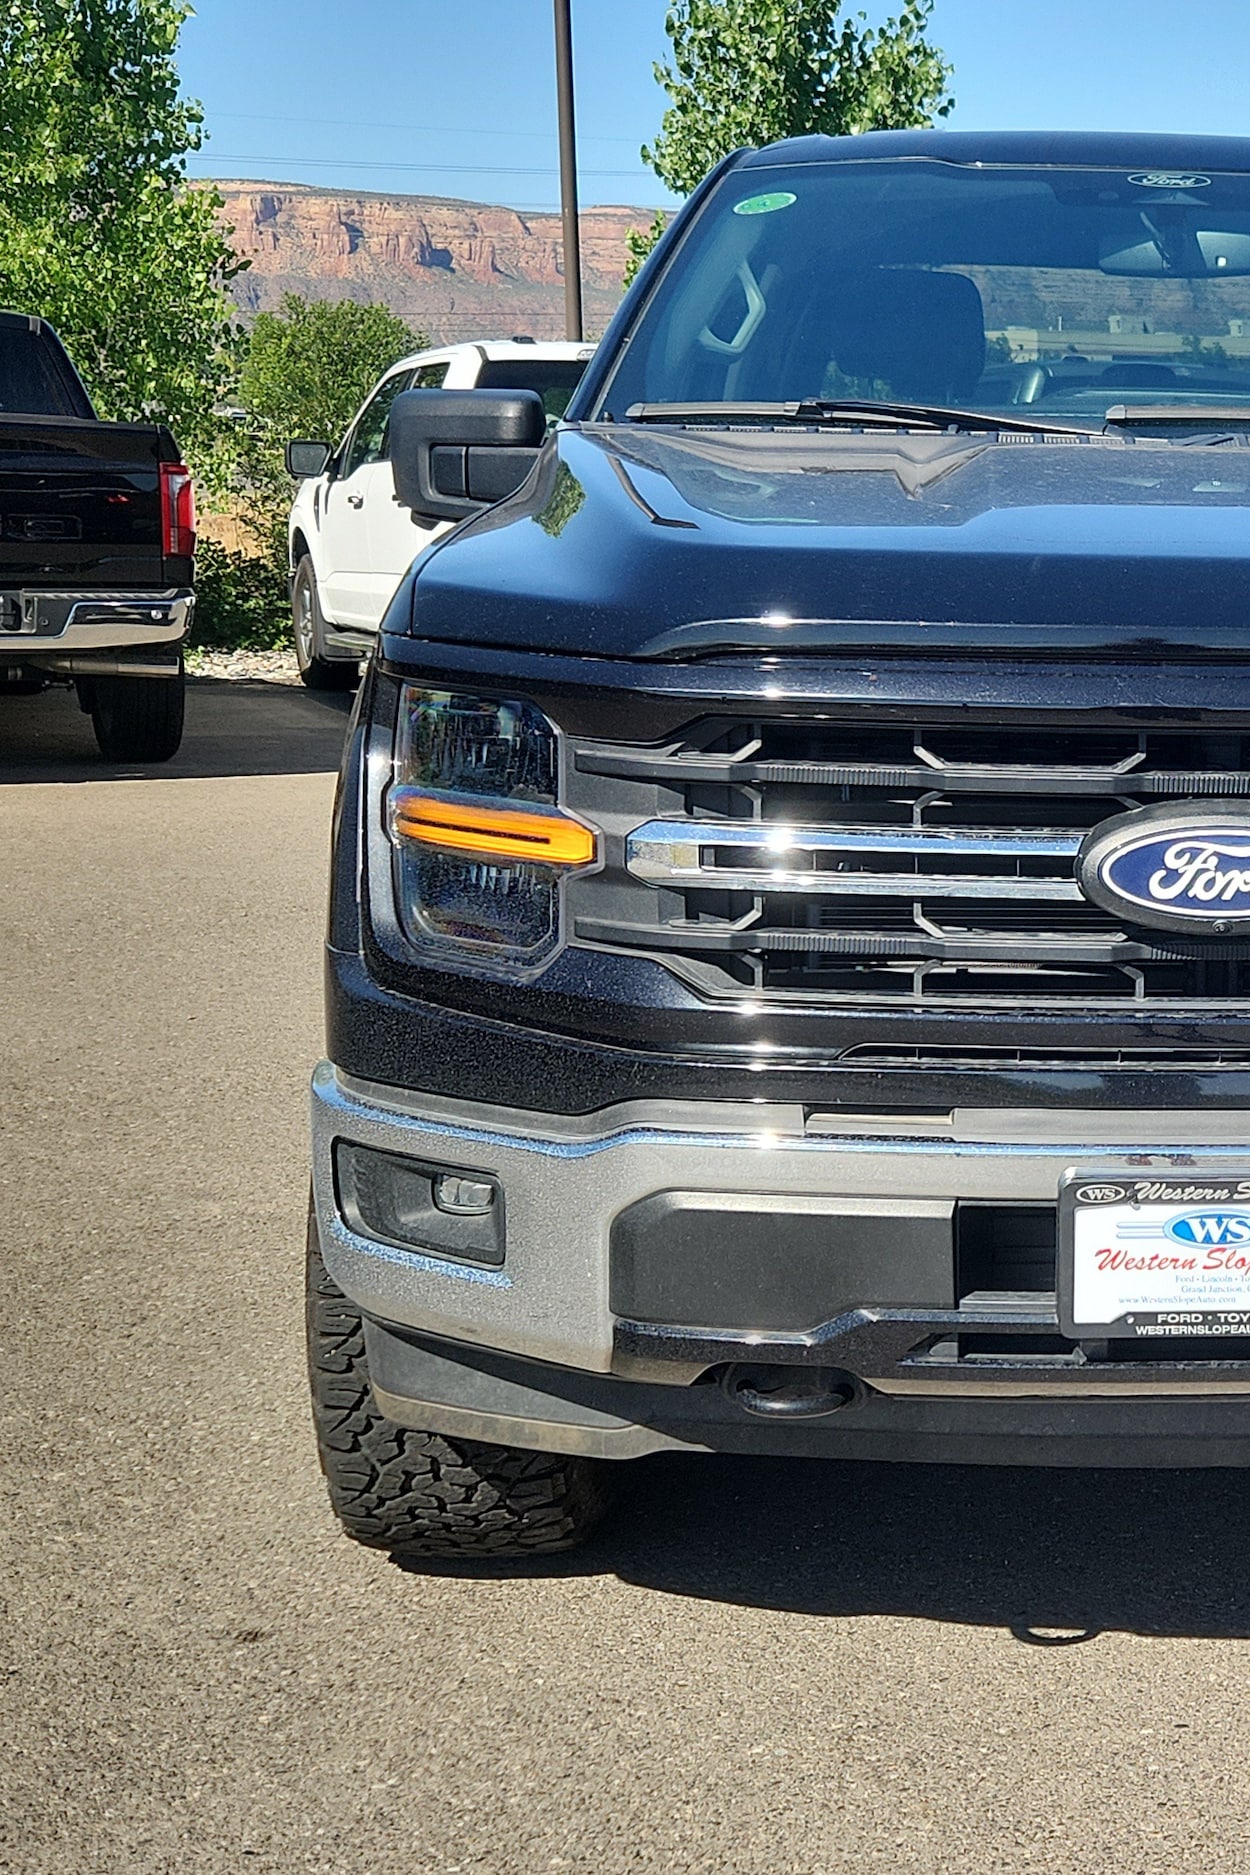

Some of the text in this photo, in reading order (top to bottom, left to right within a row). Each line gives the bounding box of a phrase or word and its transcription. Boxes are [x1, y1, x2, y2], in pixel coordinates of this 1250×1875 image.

[1142, 173, 1196, 186] Ford
[1086, 1188, 1116, 1200] WS
[1131, 1181, 1230, 1201] Western
[1094, 1248, 1198, 1271] Western
[1175, 1275, 1195, 1283] Ford
[1157, 1313, 1203, 1324] FORD
